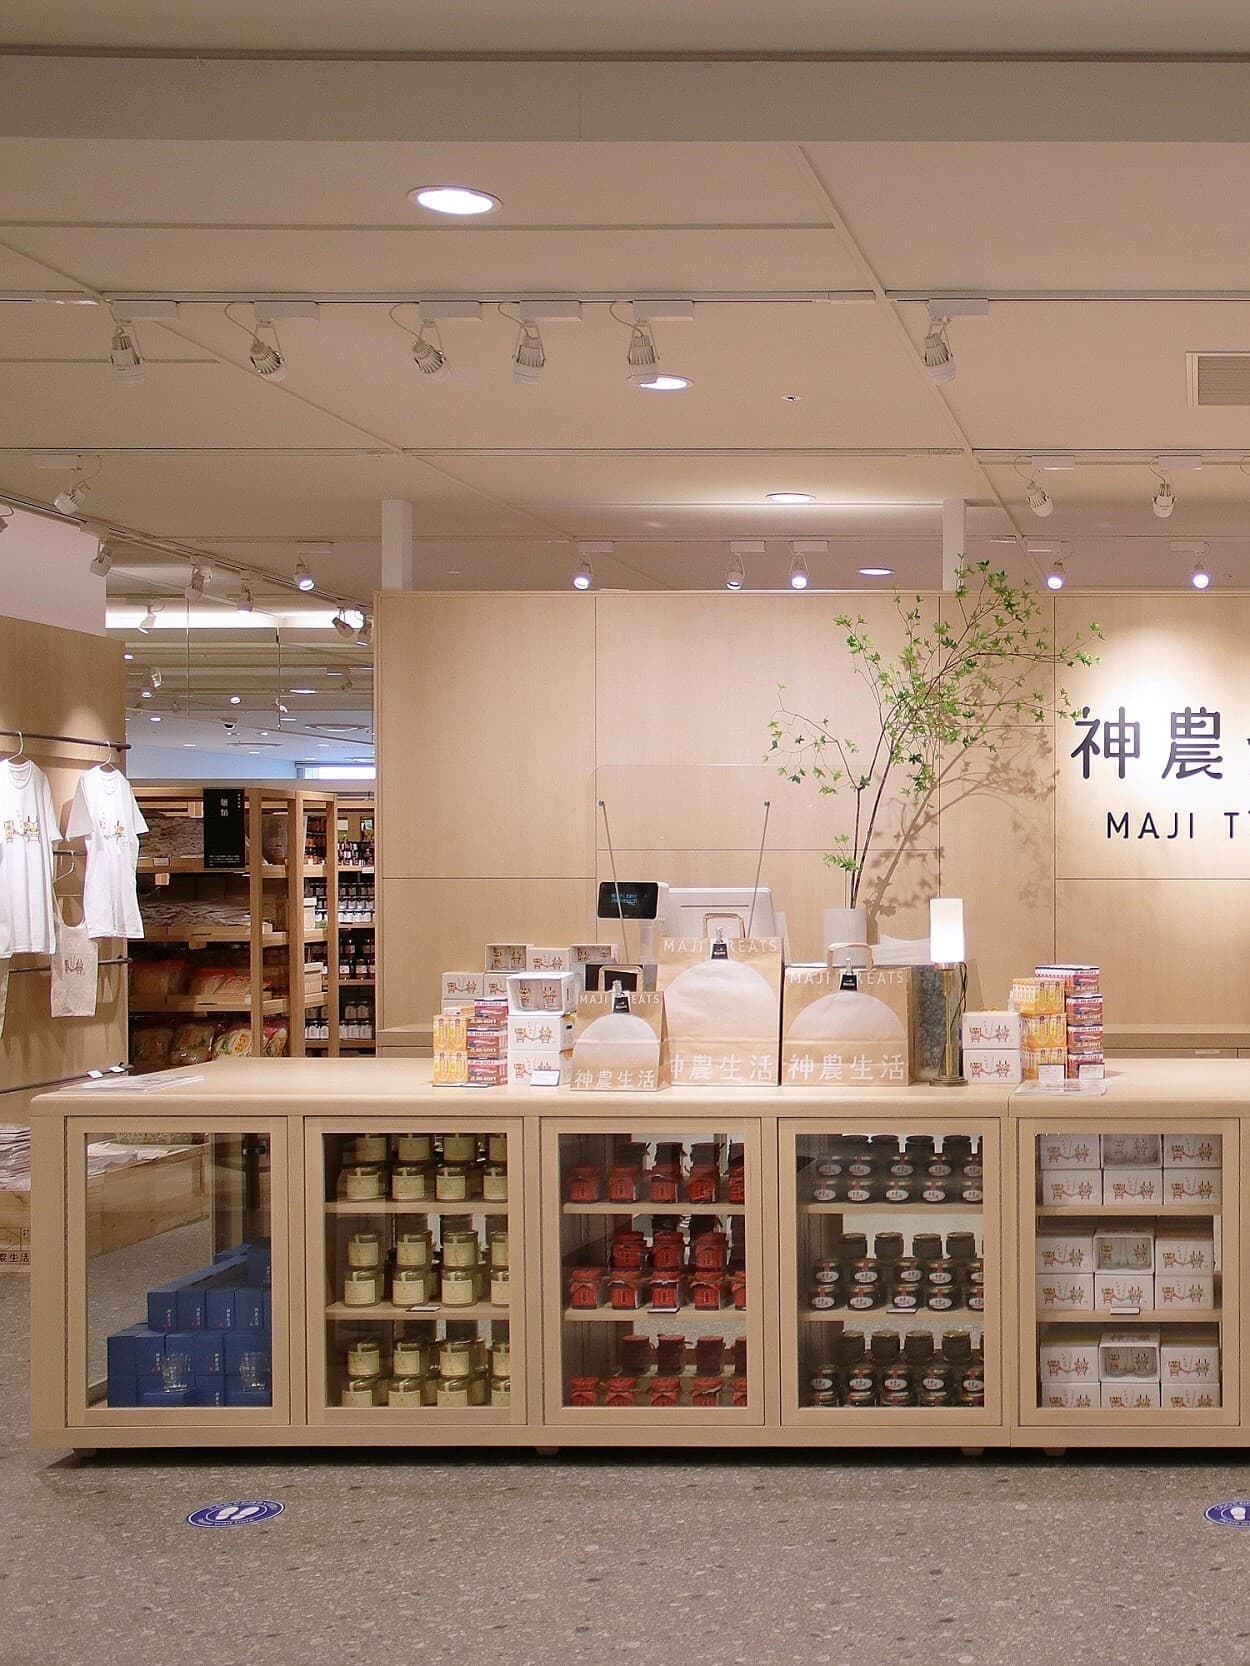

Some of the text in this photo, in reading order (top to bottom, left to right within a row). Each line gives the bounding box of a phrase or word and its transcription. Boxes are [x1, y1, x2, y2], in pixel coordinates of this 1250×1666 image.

[1106, 811, 1195, 840] MAJI
[664, 939, 777, 953] MAJI REATS
[790, 970, 904, 985] MAJI REATS
[580, 993, 660, 1005] MAJI EATS
[788, 1053, 905, 1081] 神農生活
[574, 1068, 655, 1089] 神農生活
